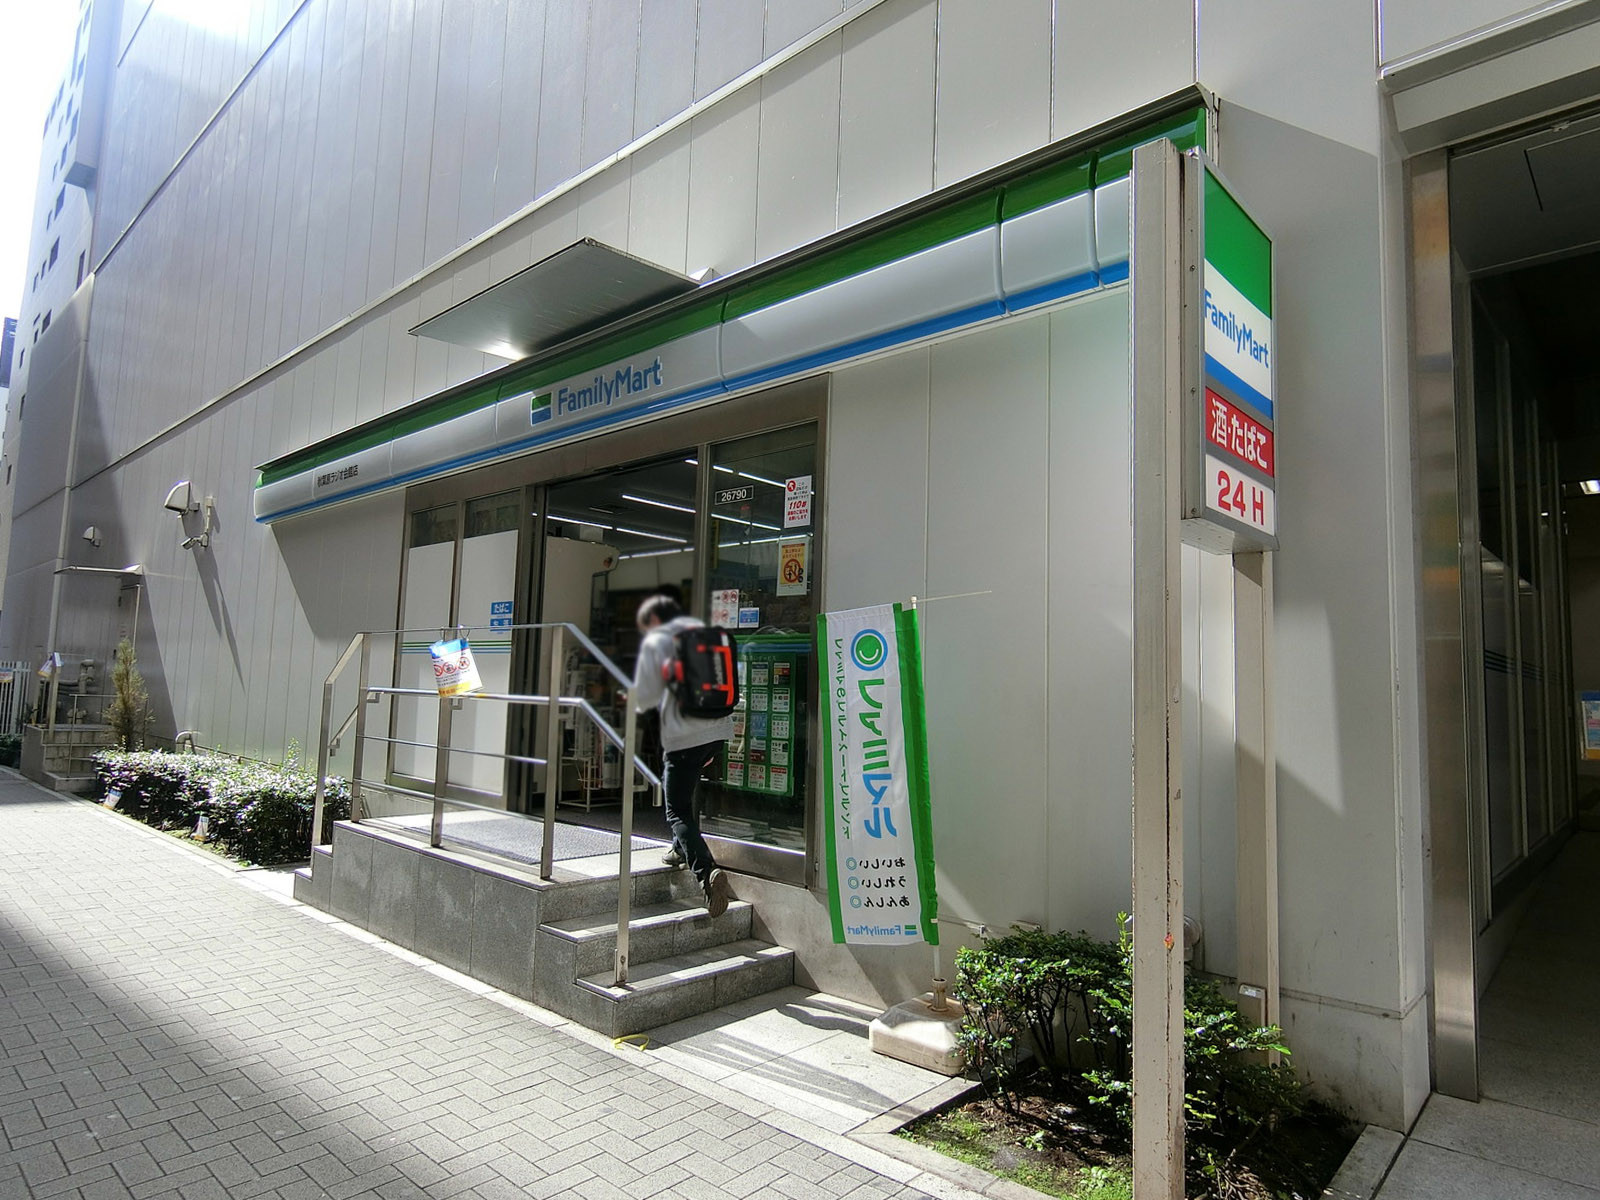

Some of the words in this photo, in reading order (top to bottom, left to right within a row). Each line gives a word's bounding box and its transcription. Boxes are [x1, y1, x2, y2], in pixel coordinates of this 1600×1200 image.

[1204, 289, 1269, 368] FamilyMart
[557, 356, 662, 416] FamilyMart
[721, 489, 747, 502] 26790
